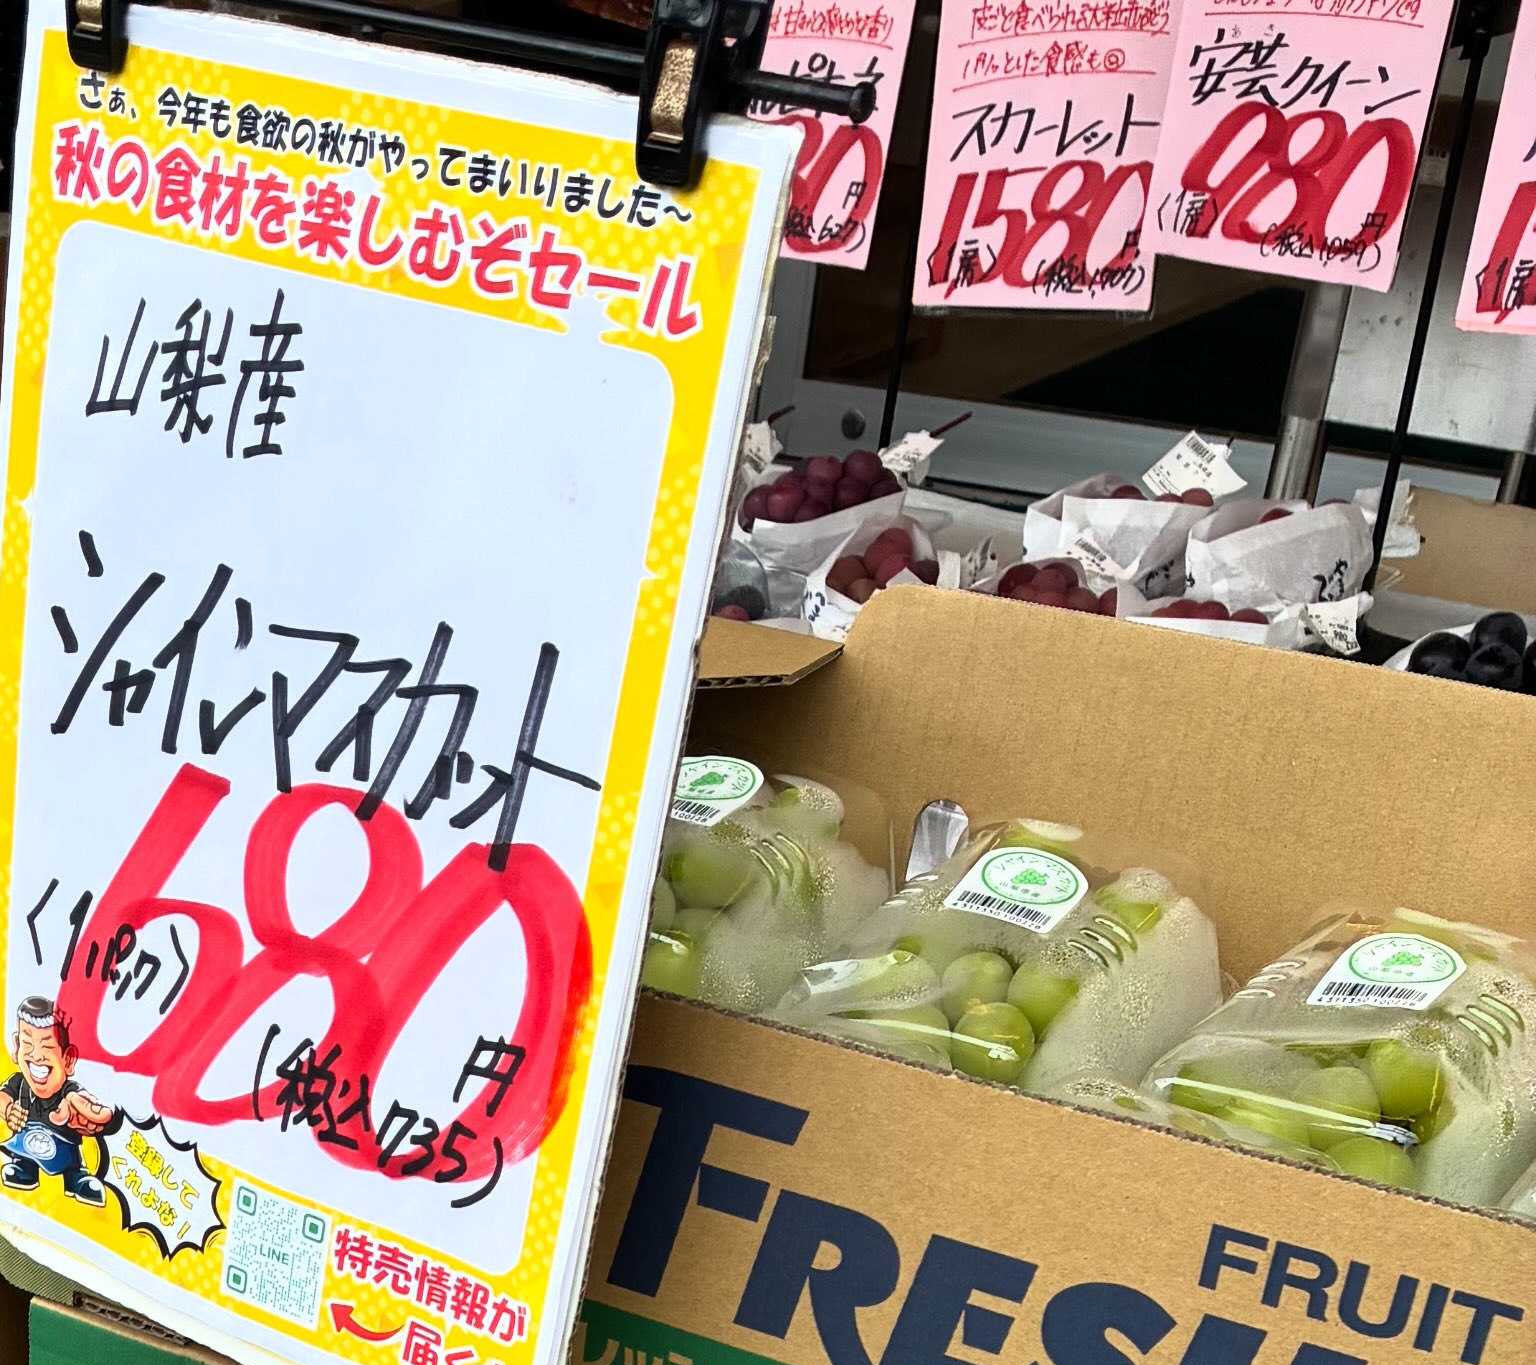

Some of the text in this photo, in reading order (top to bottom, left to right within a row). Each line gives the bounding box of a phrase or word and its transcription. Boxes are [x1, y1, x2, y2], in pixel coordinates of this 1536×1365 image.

[950, 93, 1161, 162] スカーレット
[1189, 27, 1422, 115] 安芸クイーン
[52, 123, 704, 337] 秋の食材を楽しむぞセール
[843, 181, 868, 209] 円
[931, 160, 1154, 299] 1580
[1180, 101, 1416, 252] 980
[84, 288, 306, 461] 山梨産
[50, 530, 603, 871] シャインマスカット
[56, 762, 596, 1183] 680
[454, 1036, 526, 1117] 円
[124, 1129, 201, 1212] 登録して
[258, 1243, 290, 1267] LINE
[334, 1226, 530, 1345] 特売情報が
[1197, 1224, 1525, 1365] FRUIT
